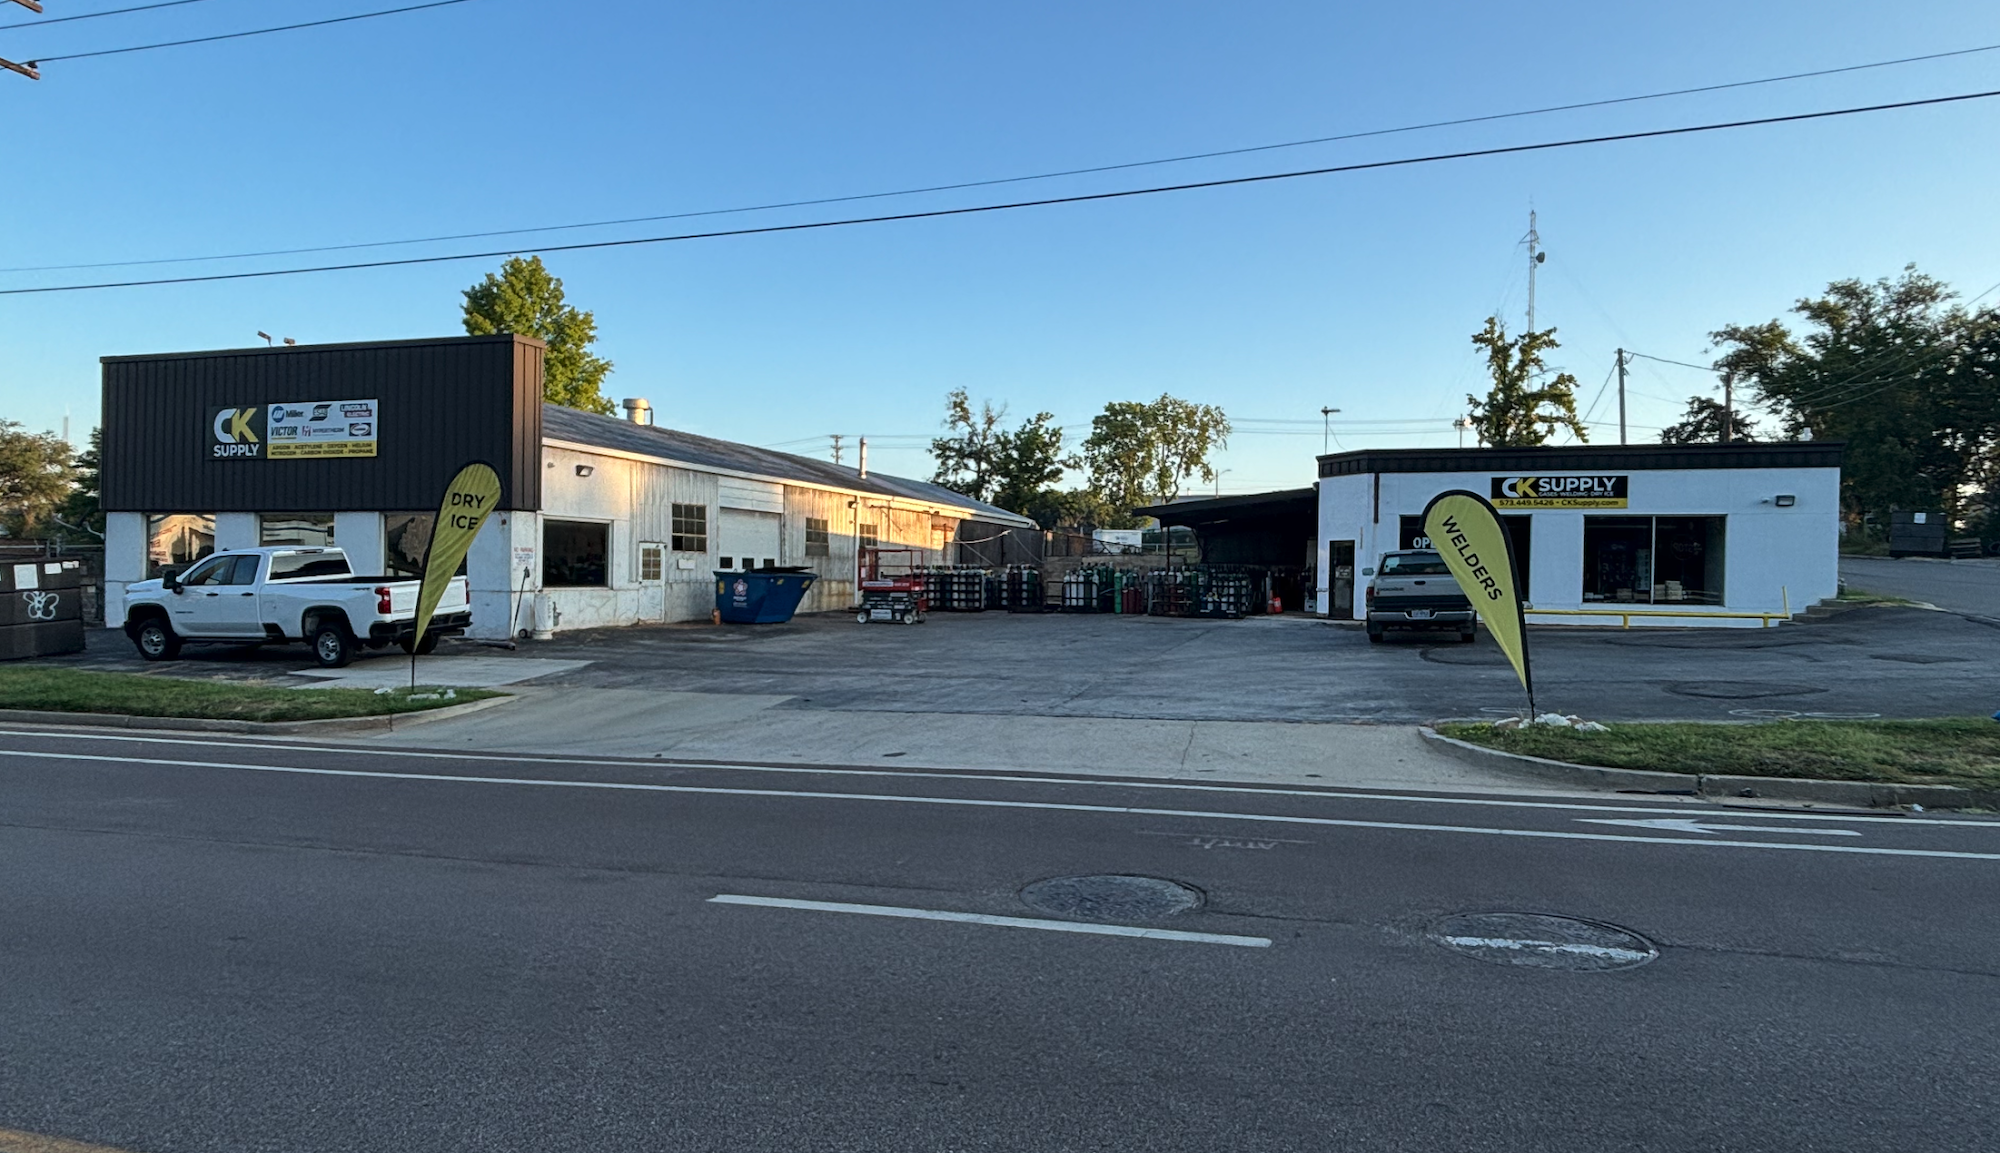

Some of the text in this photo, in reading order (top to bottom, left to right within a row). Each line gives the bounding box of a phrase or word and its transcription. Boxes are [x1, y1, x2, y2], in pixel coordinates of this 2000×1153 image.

[286, 409, 304, 418] Miller
[214, 408, 259, 443] CK
[271, 426, 298, 436] VICTOR
[213, 444, 260, 457] SUPPLY
[1501, 477, 1538, 498] CK
[1539, 478, 1616, 491] SUPPLY
[451, 493, 486, 509] DRY
[1499, 499, 1619, 508] 573.449.5426 CKSupply.com
[451, 514, 478, 530] ICE
[1441, 515, 1503, 601] WELDERS
